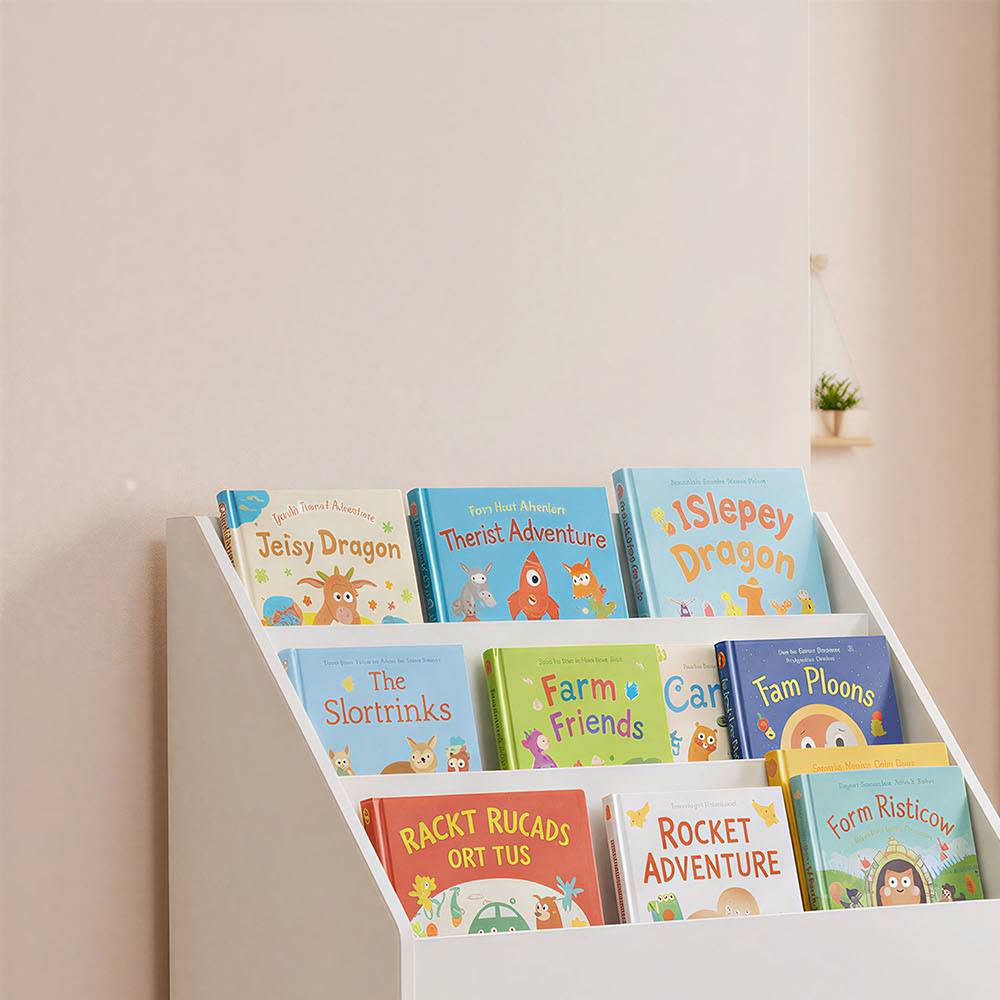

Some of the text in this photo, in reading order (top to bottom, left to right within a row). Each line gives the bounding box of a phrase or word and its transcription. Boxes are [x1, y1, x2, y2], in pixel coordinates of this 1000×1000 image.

[255, 531, 315, 565] Jeisy
[317, 529, 401, 565] Dragon
[439, 517, 607, 552] Therist Adventure
[669, 540, 796, 584] Dragon
[368, 670, 407, 691] The
[540, 673, 617, 707] Farm
[803, 666, 876, 708] Ploons
[323, 694, 452, 726] Slortrinks
[549, 708, 645, 743] Friends
[399, 806, 571, 856] RACKT RUCADS
[657, 816, 751, 850] ROCKET
[826, 805, 874, 840] Form
[874, 793, 956, 837] Risticow
[447, 844, 532, 869] ORT TUS
[643, 850, 782, 885] ADVENTURE
